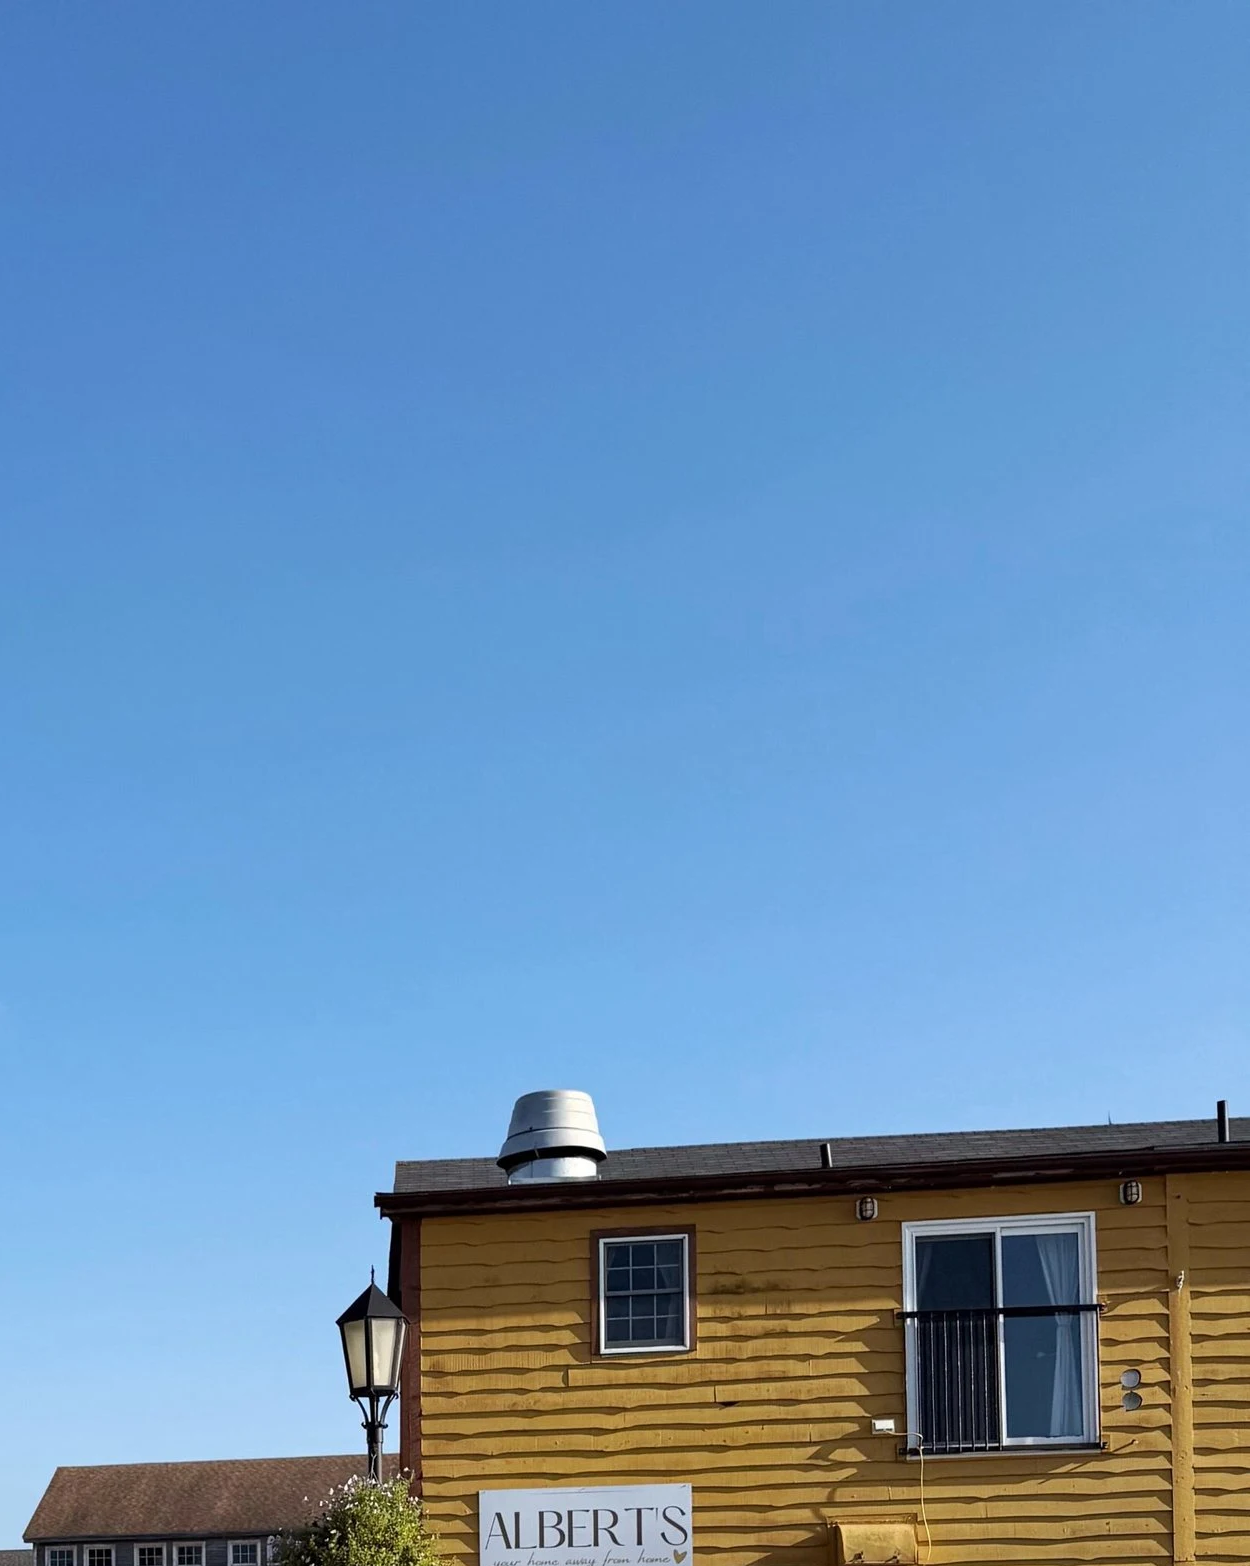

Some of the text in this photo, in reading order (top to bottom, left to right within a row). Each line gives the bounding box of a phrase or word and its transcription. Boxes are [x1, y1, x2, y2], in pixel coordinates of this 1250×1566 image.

[485, 1506, 688, 1550] ALBERT'S
[527, 1552, 559, 1566] home
[637, 1549, 671, 1564] home
